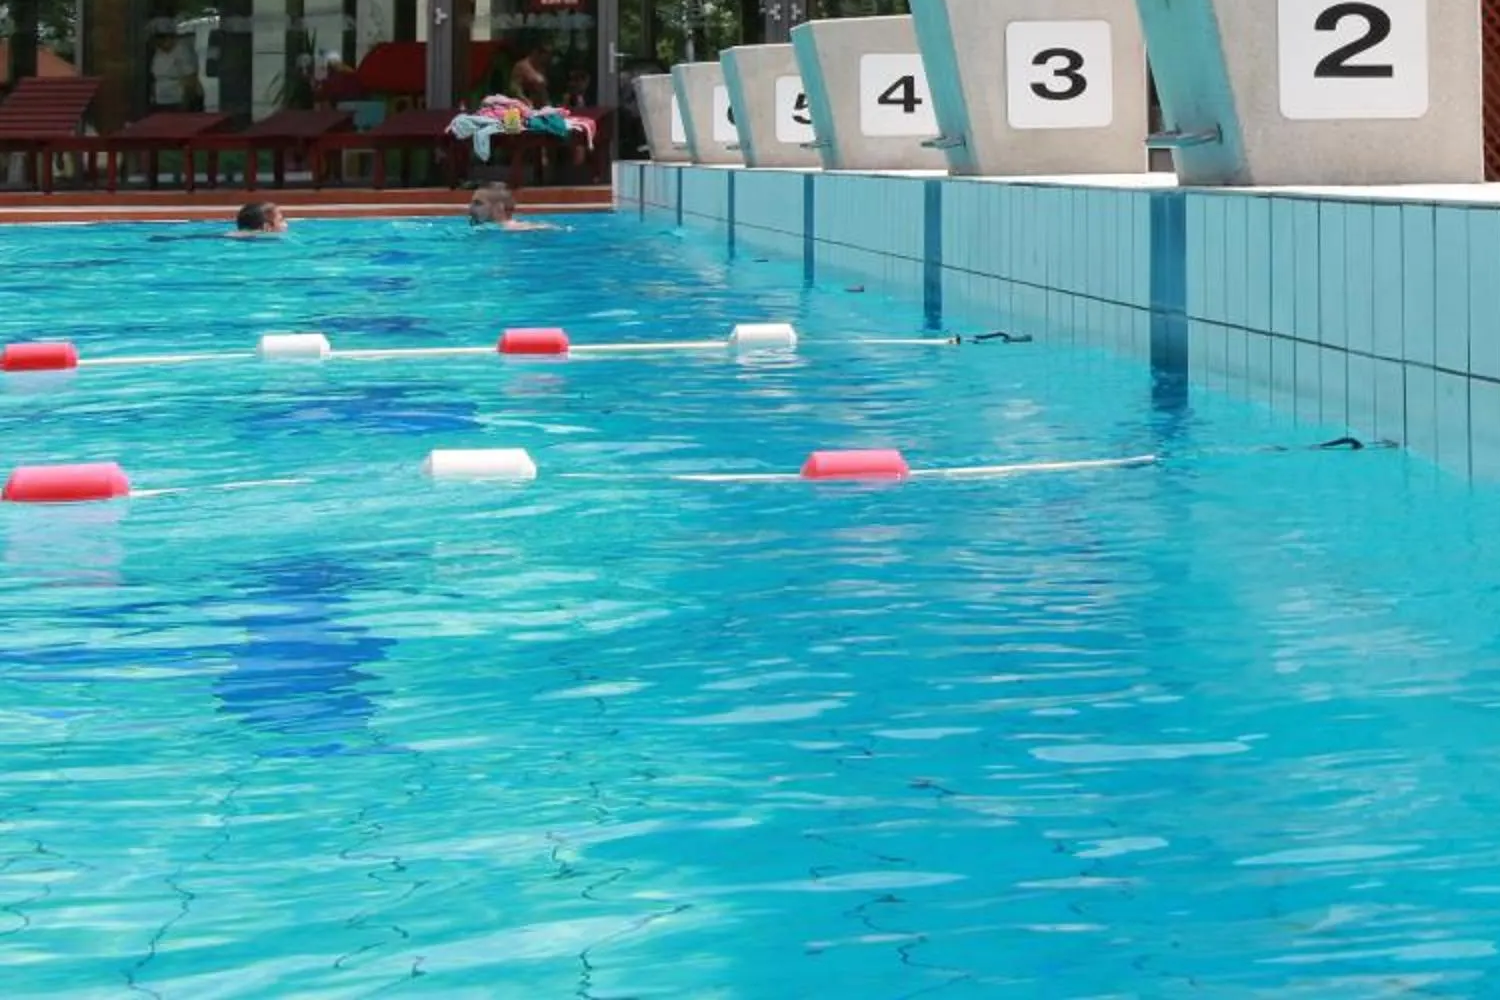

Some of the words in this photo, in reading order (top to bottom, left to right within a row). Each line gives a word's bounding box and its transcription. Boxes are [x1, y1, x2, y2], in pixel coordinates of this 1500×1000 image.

[1313, 1, 1394, 78] 2
[877, 75, 923, 113] 4
[1029, 47, 1088, 101] 3
